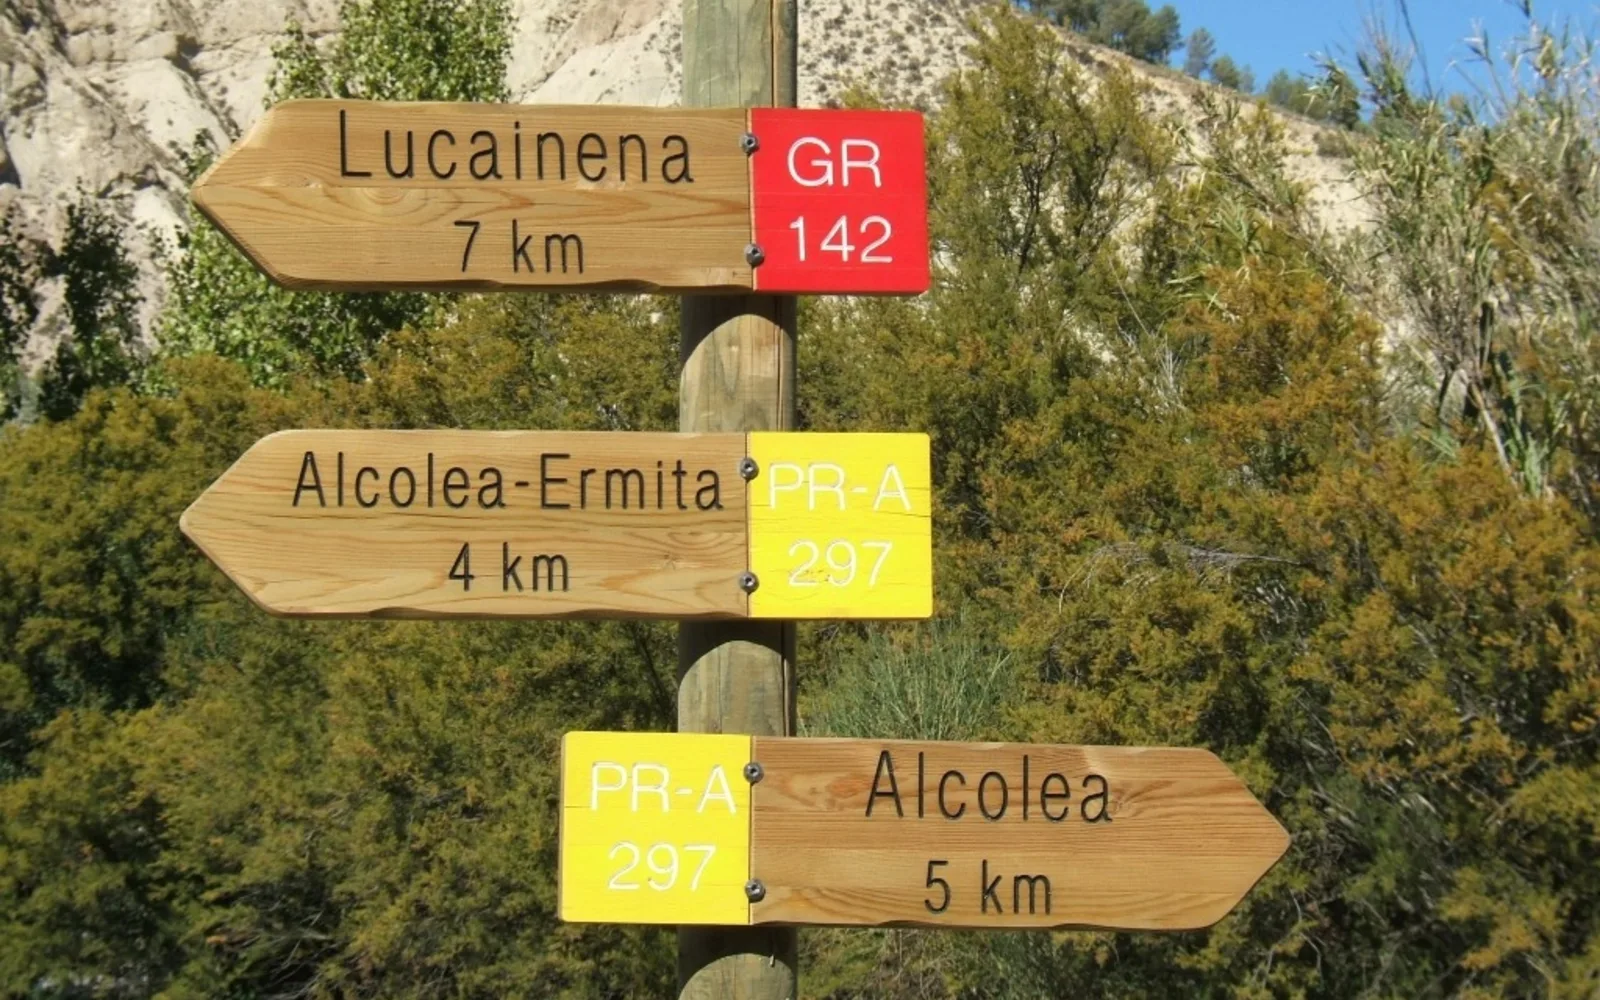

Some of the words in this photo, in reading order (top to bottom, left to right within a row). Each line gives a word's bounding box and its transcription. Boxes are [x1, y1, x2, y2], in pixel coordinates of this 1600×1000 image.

[339, 109, 694, 184] Lucainena
[787, 137, 882, 189] GR
[454, 221, 480, 273] 7
[511, 218, 584, 274] km
[790, 216, 893, 264] 142
[292, 451, 723, 510] Alcolea-Ermita
[768, 463, 912, 512] PR-A
[448, 542, 474, 591] 4
[502, 542, 569, 593] km
[787, 540, 893, 588] 297
[590, 761, 737, 815] PR-A
[865, 750, 1113, 823] Alcolea
[607, 842, 716, 893] 297
[925, 860, 949, 914] 5
[982, 860, 1052, 915] km
